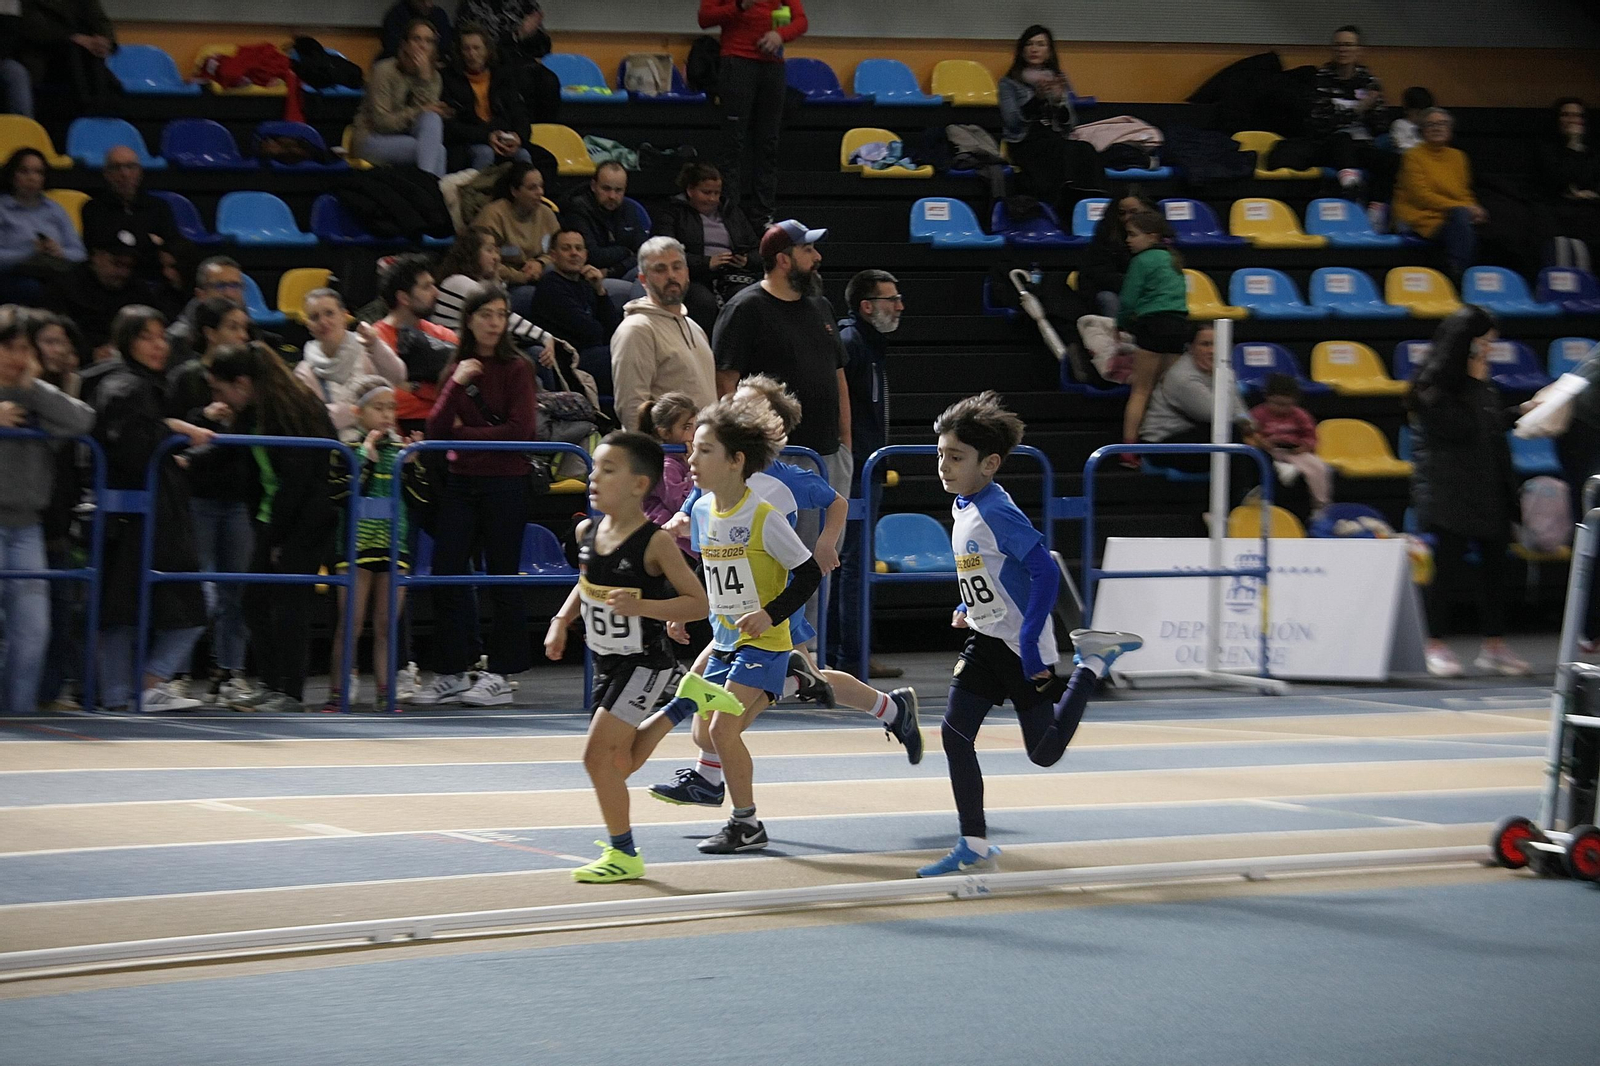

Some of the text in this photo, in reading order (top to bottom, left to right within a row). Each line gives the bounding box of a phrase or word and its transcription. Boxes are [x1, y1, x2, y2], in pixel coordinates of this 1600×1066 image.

[722, 546, 744, 558] 2025
[963, 556, 981, 569] 2025
[705, 565, 744, 596] 714
[1160, 617, 1313, 640] DEPTACIÓN
